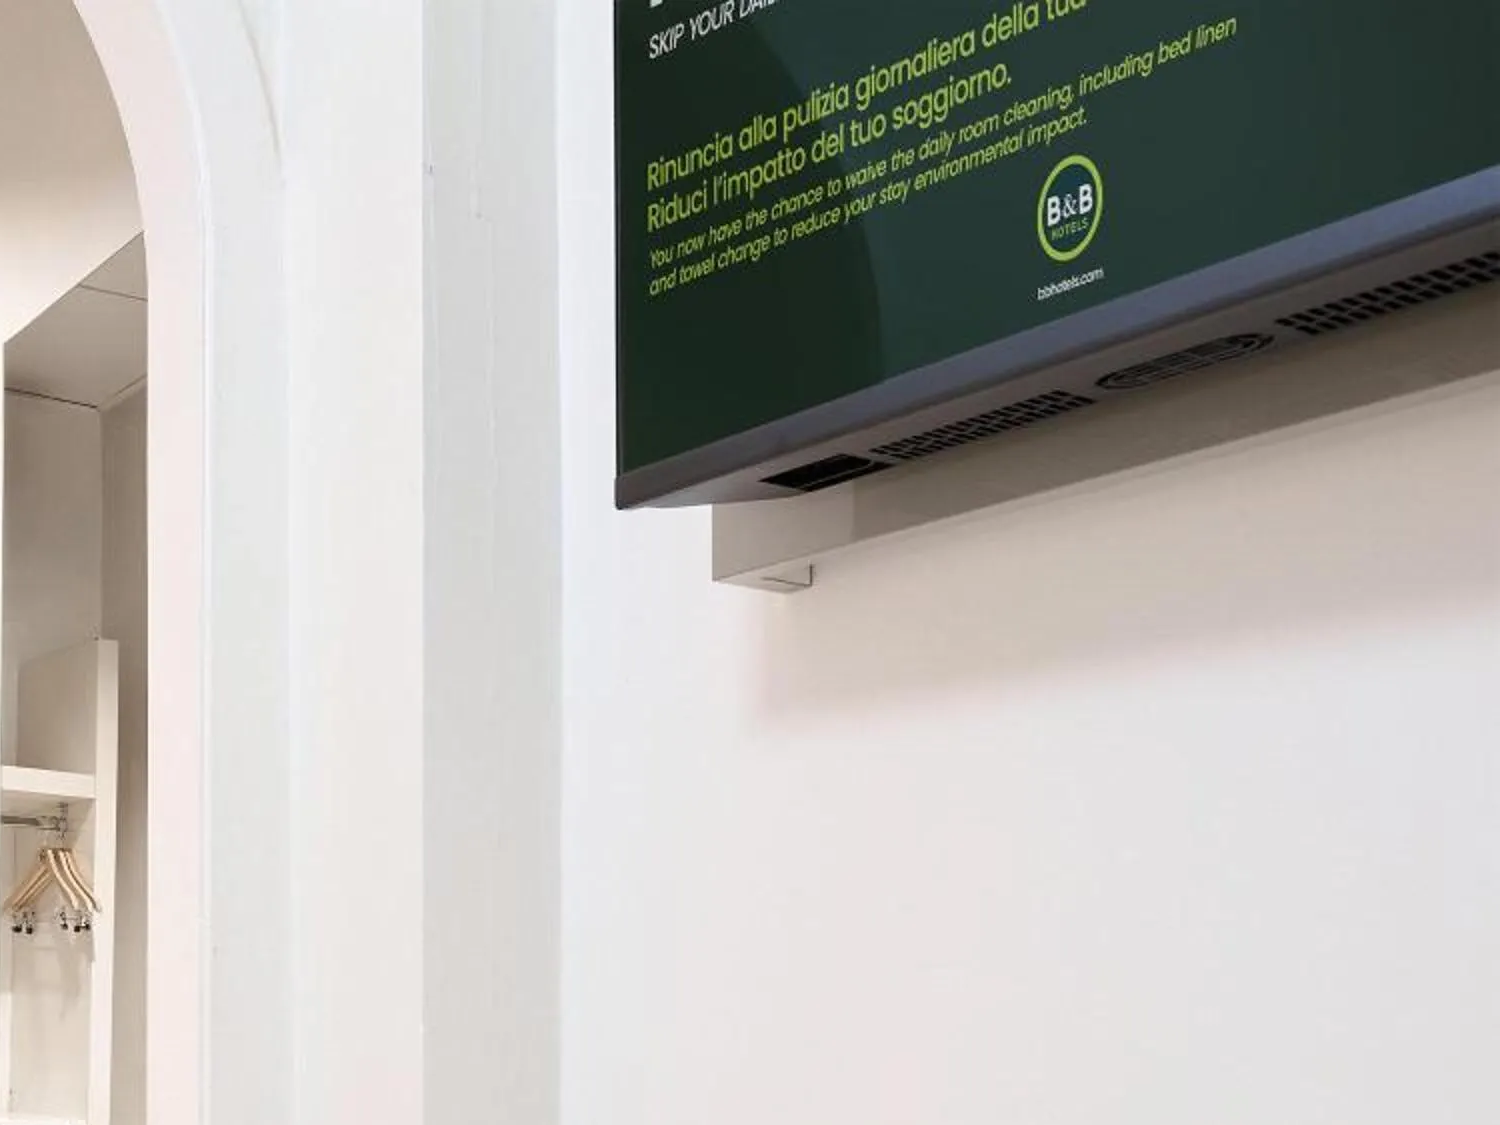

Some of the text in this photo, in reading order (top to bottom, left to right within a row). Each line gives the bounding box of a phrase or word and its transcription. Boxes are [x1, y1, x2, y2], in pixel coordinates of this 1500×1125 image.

[649, 22, 685, 59] SKIP
[690, 0, 735, 41] YOUR
[647, 132, 734, 191] Rinuncia
[739, 114, 777, 151] alla
[783, 82, 850, 143] pulizia
[855, 29, 976, 111] giornaliera
[981, 2, 1039, 48] della
[647, 63, 1013, 233] Riduci l'impatto del tuo soggiorno.
[651, 17, 1237, 269] You now have the chance to waive the daily room cleaning, including bed linen
[649, 105, 1087, 296] and towel change to reduce your stay environmental impact.
[1047, 183, 1093, 227] B&B
[1051, 217, 1089, 240] HOTELS
[1037, 267, 1104, 301] bbhotels.com
